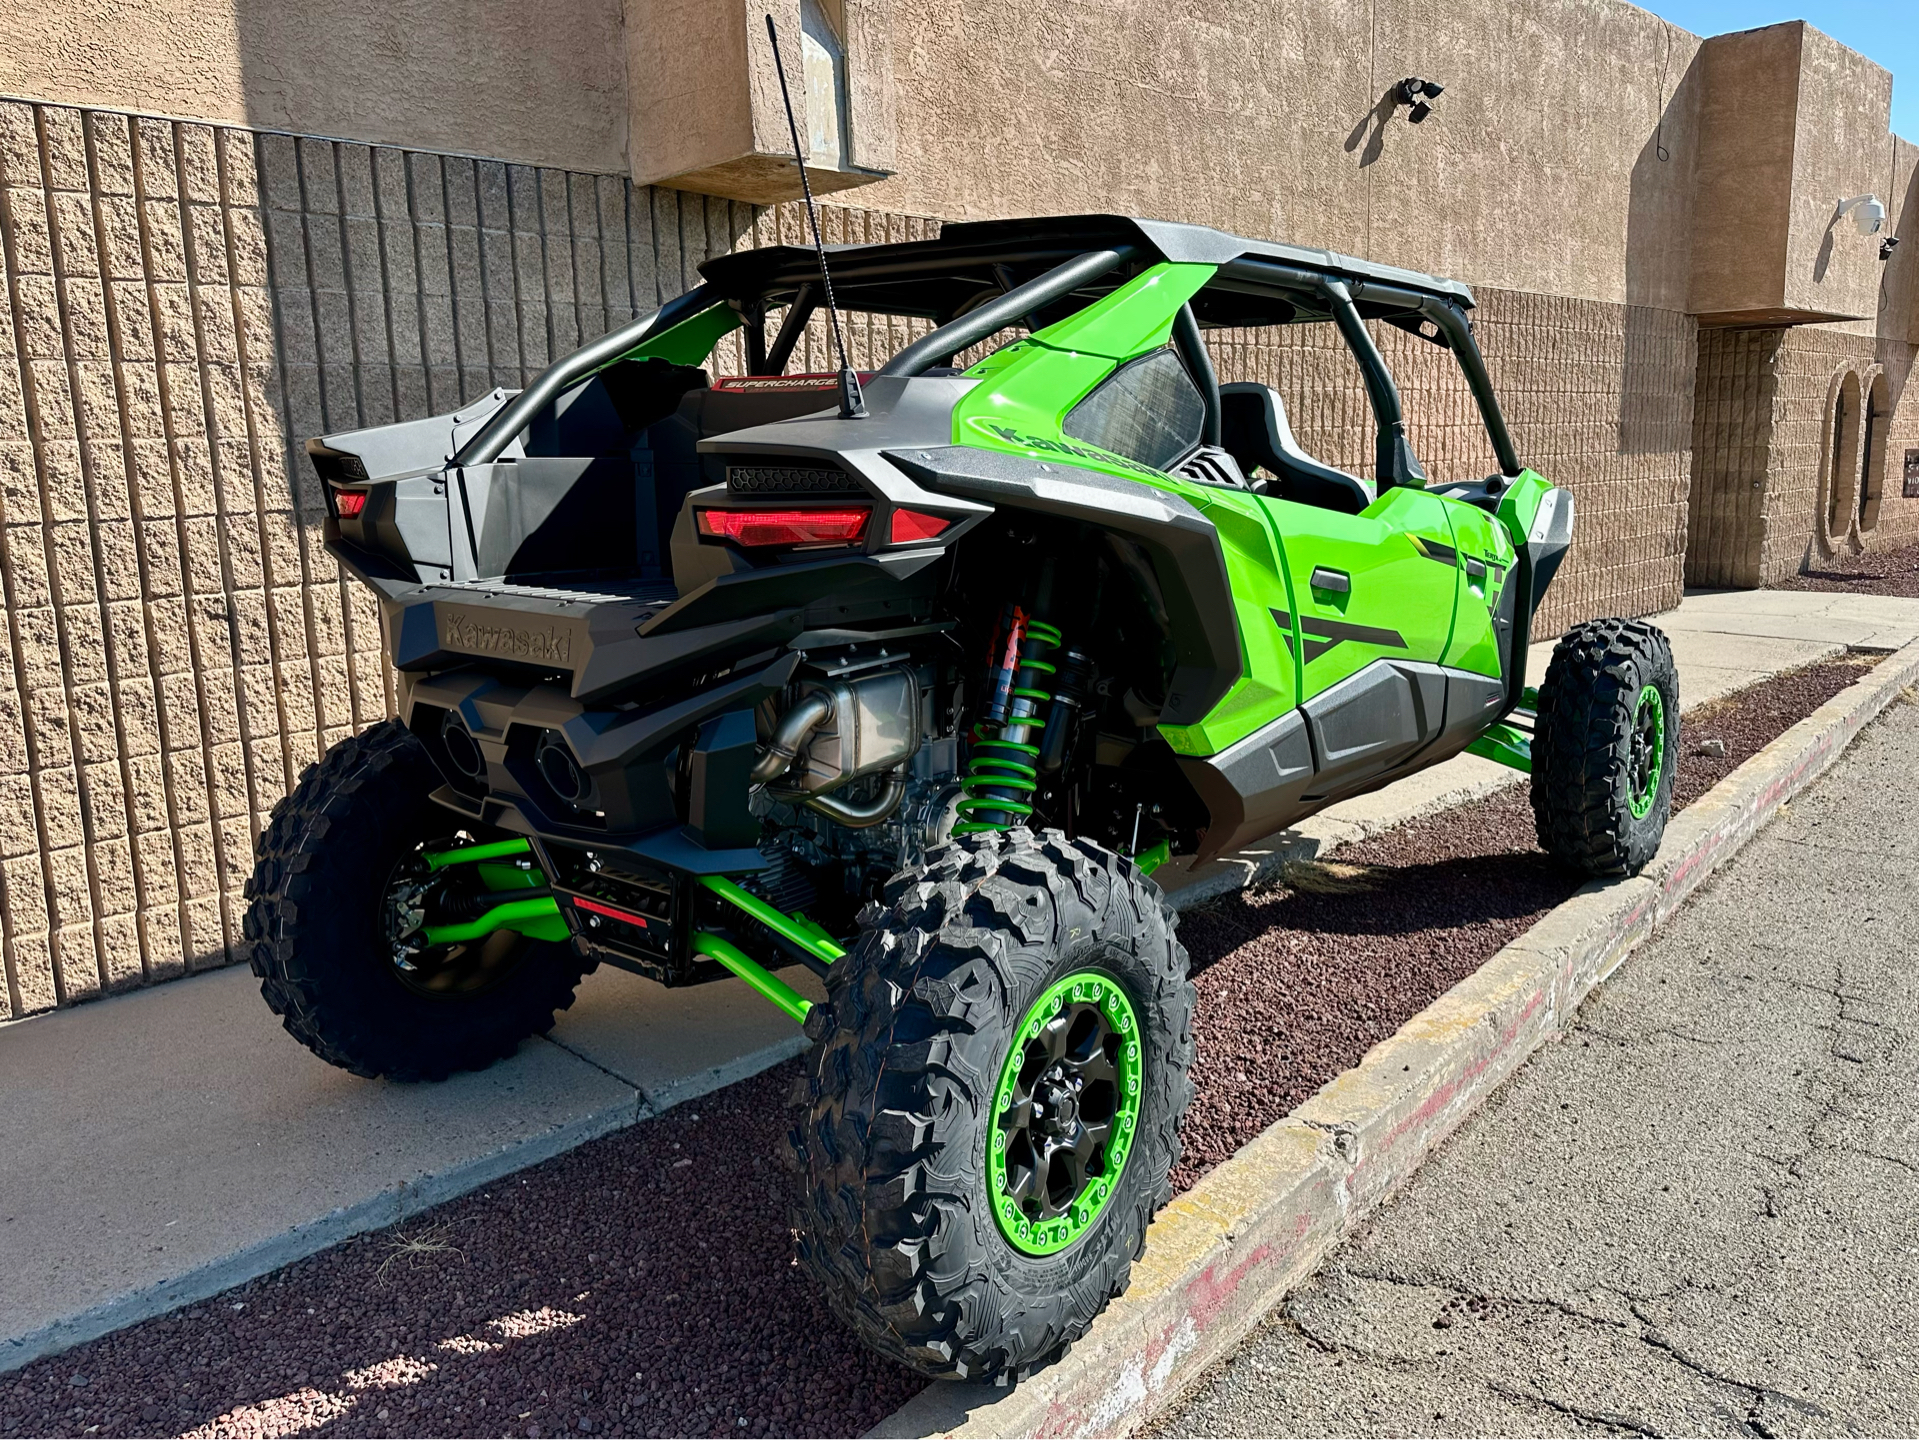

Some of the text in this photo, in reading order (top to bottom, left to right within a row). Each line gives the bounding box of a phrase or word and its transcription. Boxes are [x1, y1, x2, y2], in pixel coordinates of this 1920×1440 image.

[725, 378, 838, 388] SUPERCHARGE
[989, 424, 1180, 486] Kawasaki
[446, 613, 572, 663] Kawasaki
